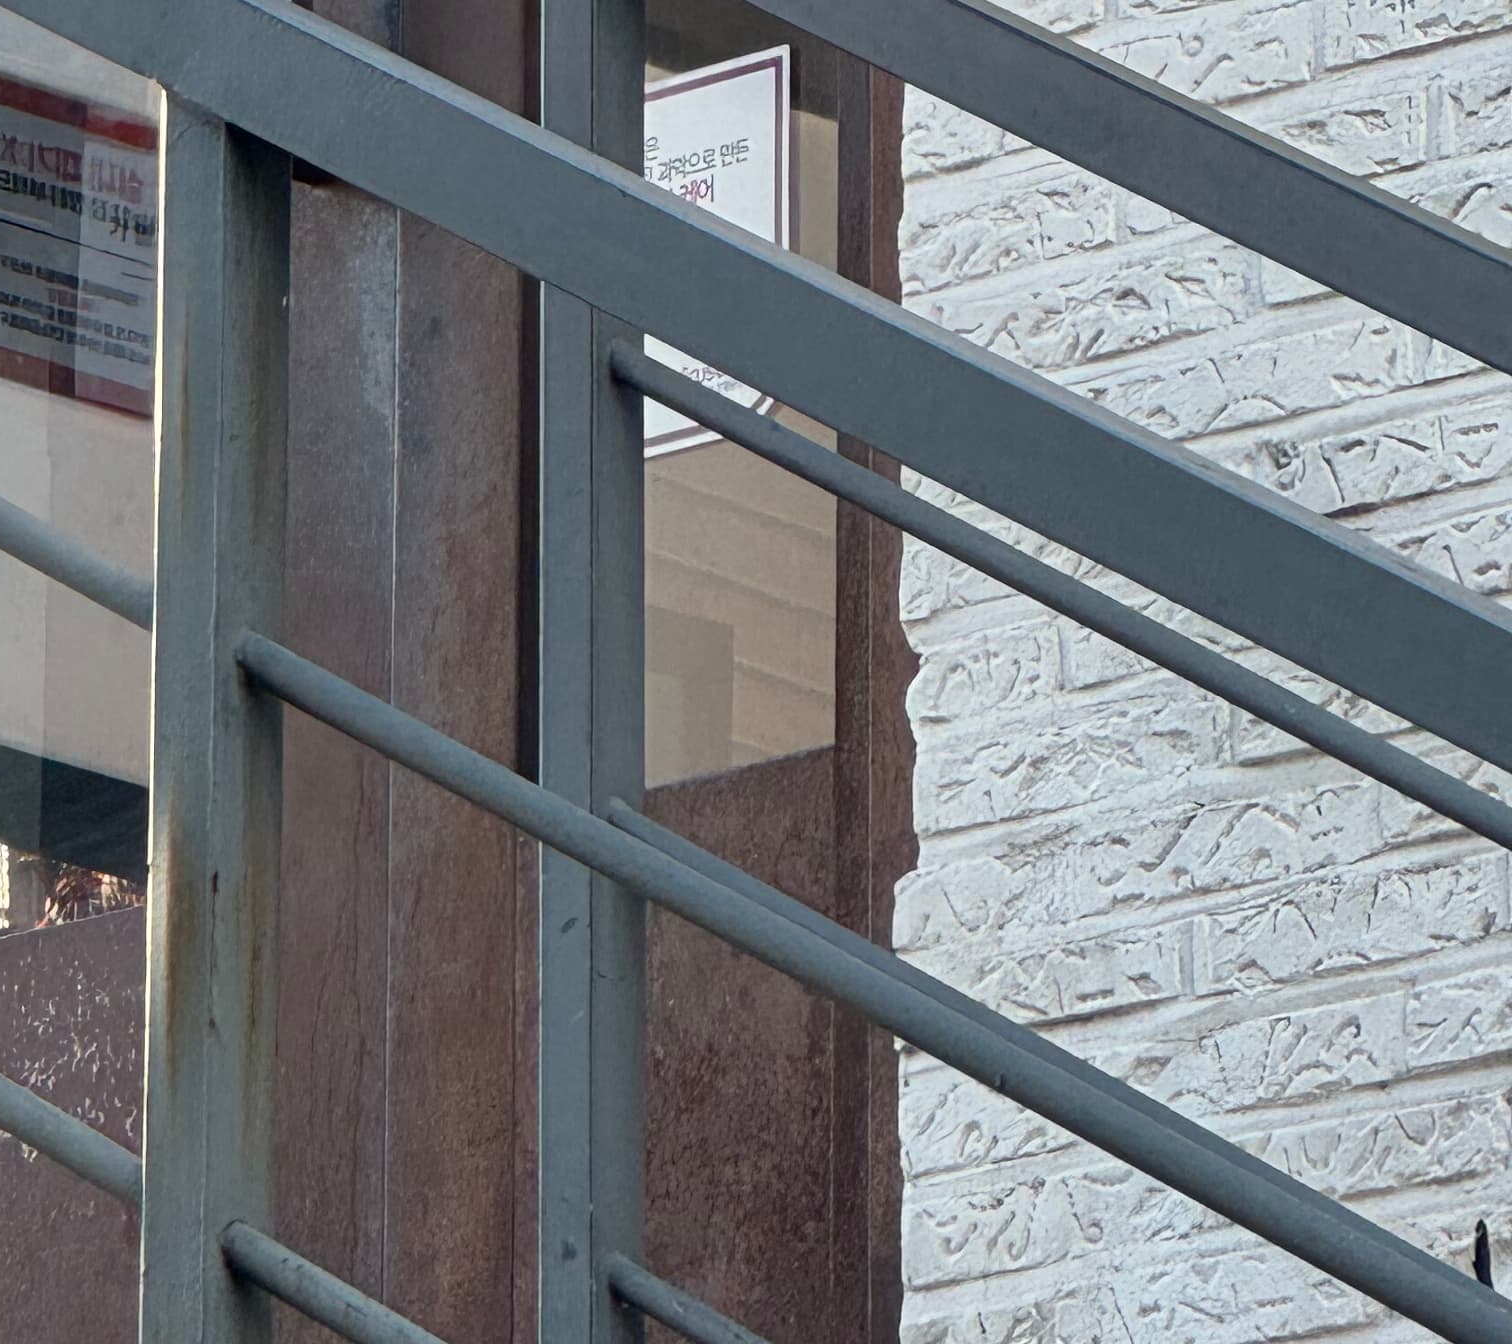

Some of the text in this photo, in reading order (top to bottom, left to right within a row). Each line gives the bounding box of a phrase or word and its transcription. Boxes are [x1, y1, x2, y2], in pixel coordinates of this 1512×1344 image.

[657, 137, 750, 183] 과학으로 만든
[679, 173, 715, 204] 케어
